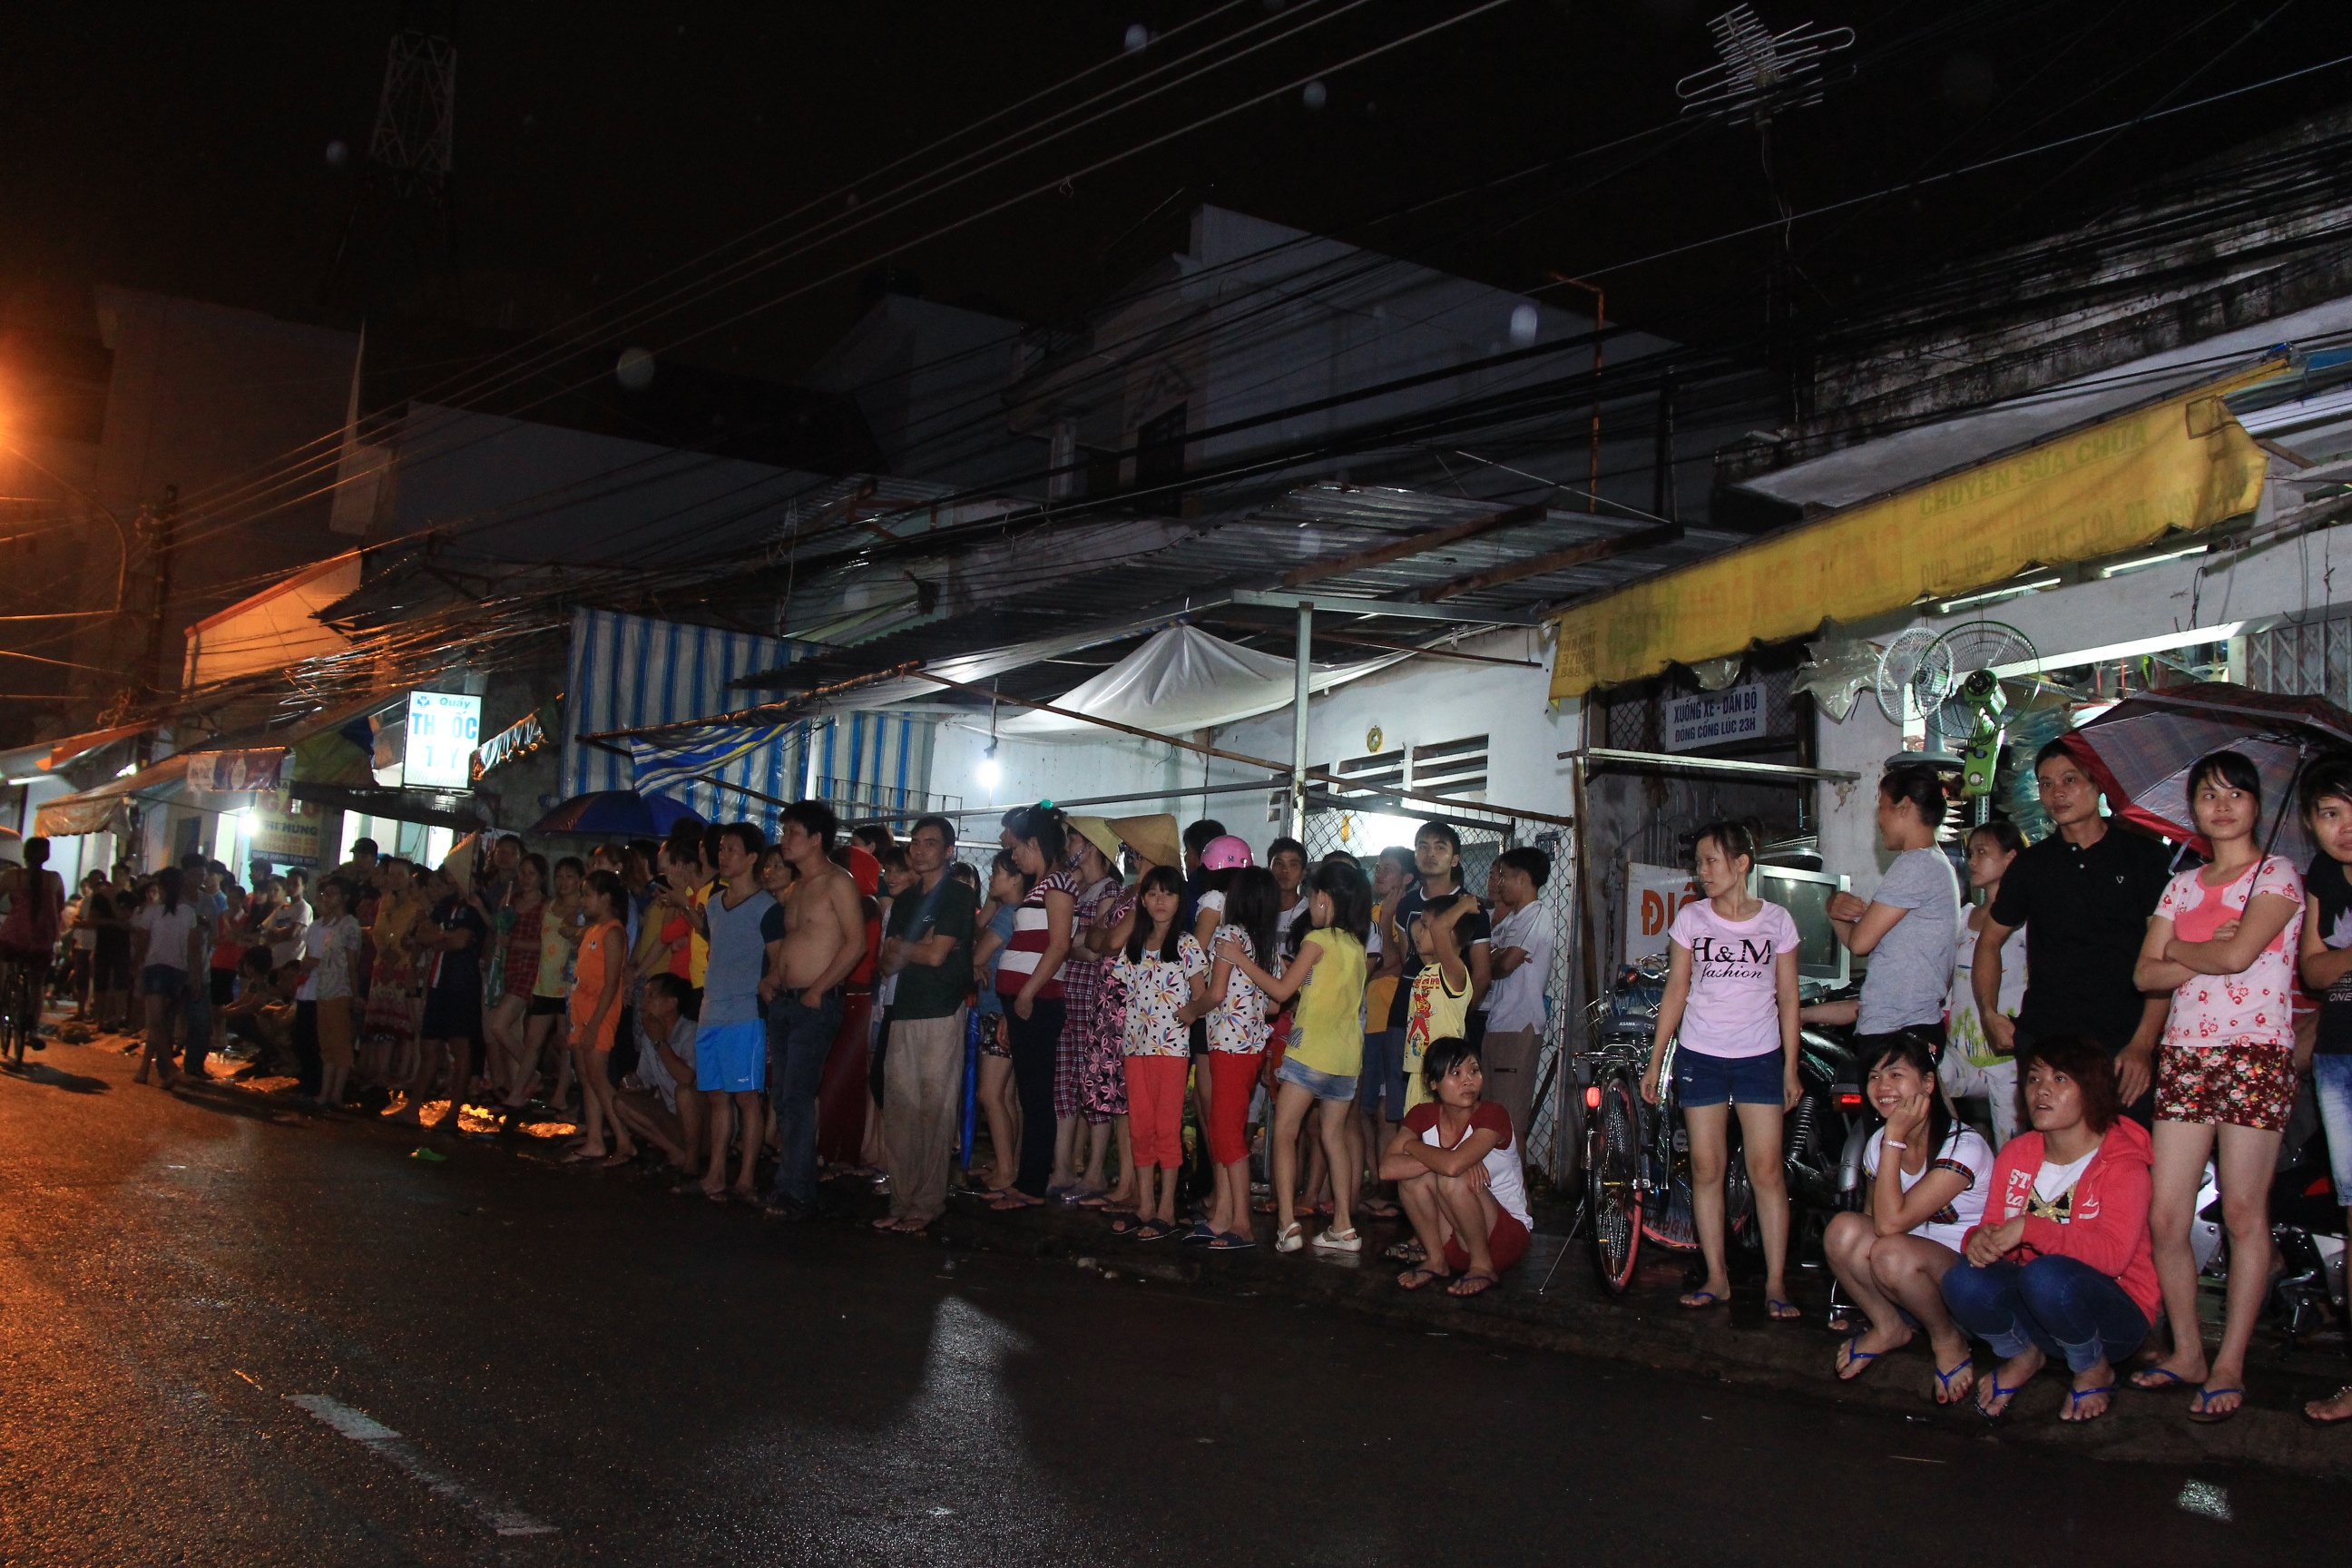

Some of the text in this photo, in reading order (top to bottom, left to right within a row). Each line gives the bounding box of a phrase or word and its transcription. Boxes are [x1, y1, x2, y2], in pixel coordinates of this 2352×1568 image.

[1919, 473, 2011, 515] CHUYÊN
[1703, 699, 1714, 718] XE
[1745, 687, 1757, 714] BỘ
[411, 712, 477, 740] THỐC
[1675, 725, 1695, 742] ĐÓNG
[1721, 717, 1737, 735] LÚC
[1739, 717, 1756, 732] 23H
[426, 745, 459, 769] TY
[1692, 937, 1771, 965] H&M
[1700, 962, 1762, 982] fashion
